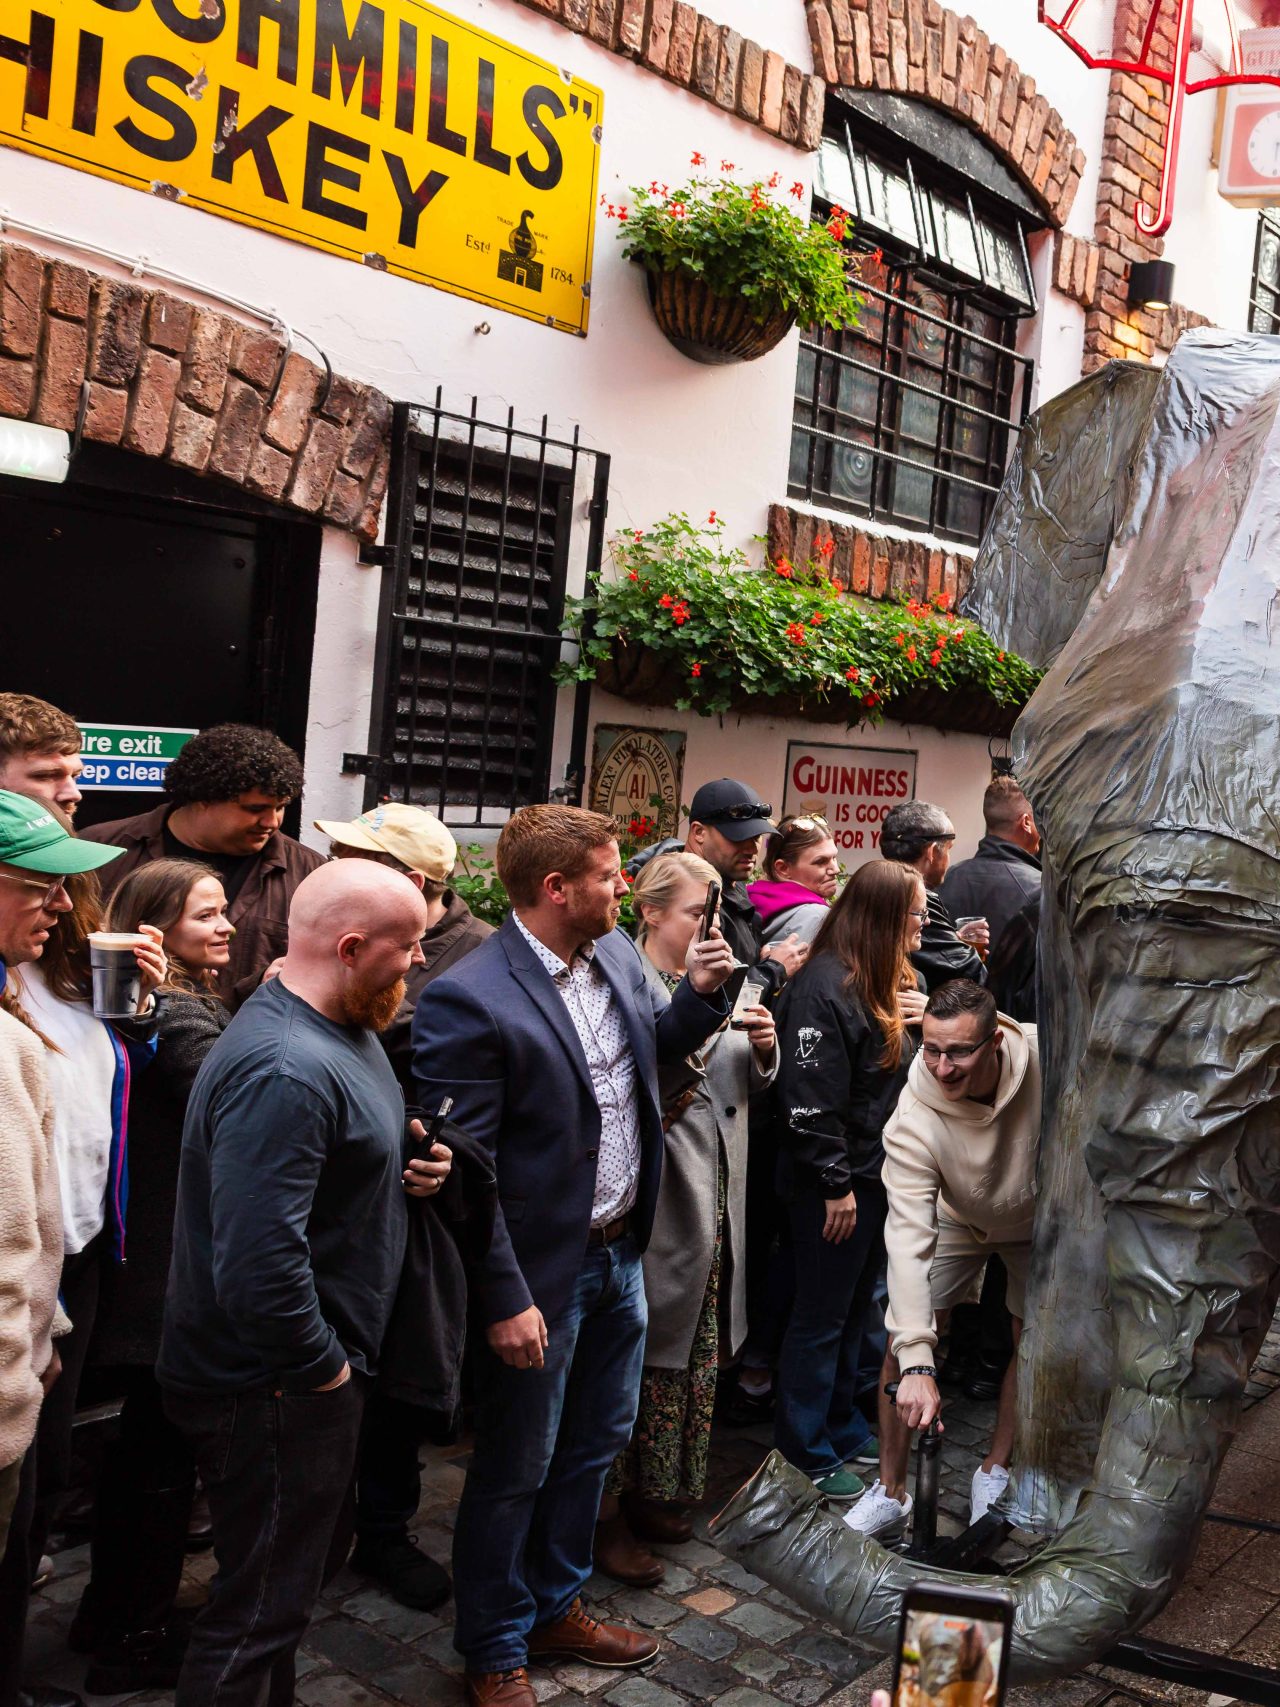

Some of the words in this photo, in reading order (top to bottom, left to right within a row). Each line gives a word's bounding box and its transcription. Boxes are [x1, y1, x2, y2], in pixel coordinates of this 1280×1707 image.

[80, 731, 112, 752] ire
[119, 735, 162, 754] exit
[78, 764, 110, 783] ep
[793, 756, 908, 797] GUINNESS
[836, 803, 850, 822] IS
[856, 804, 891, 823] GOO
[834, 830, 863, 849] FOR
